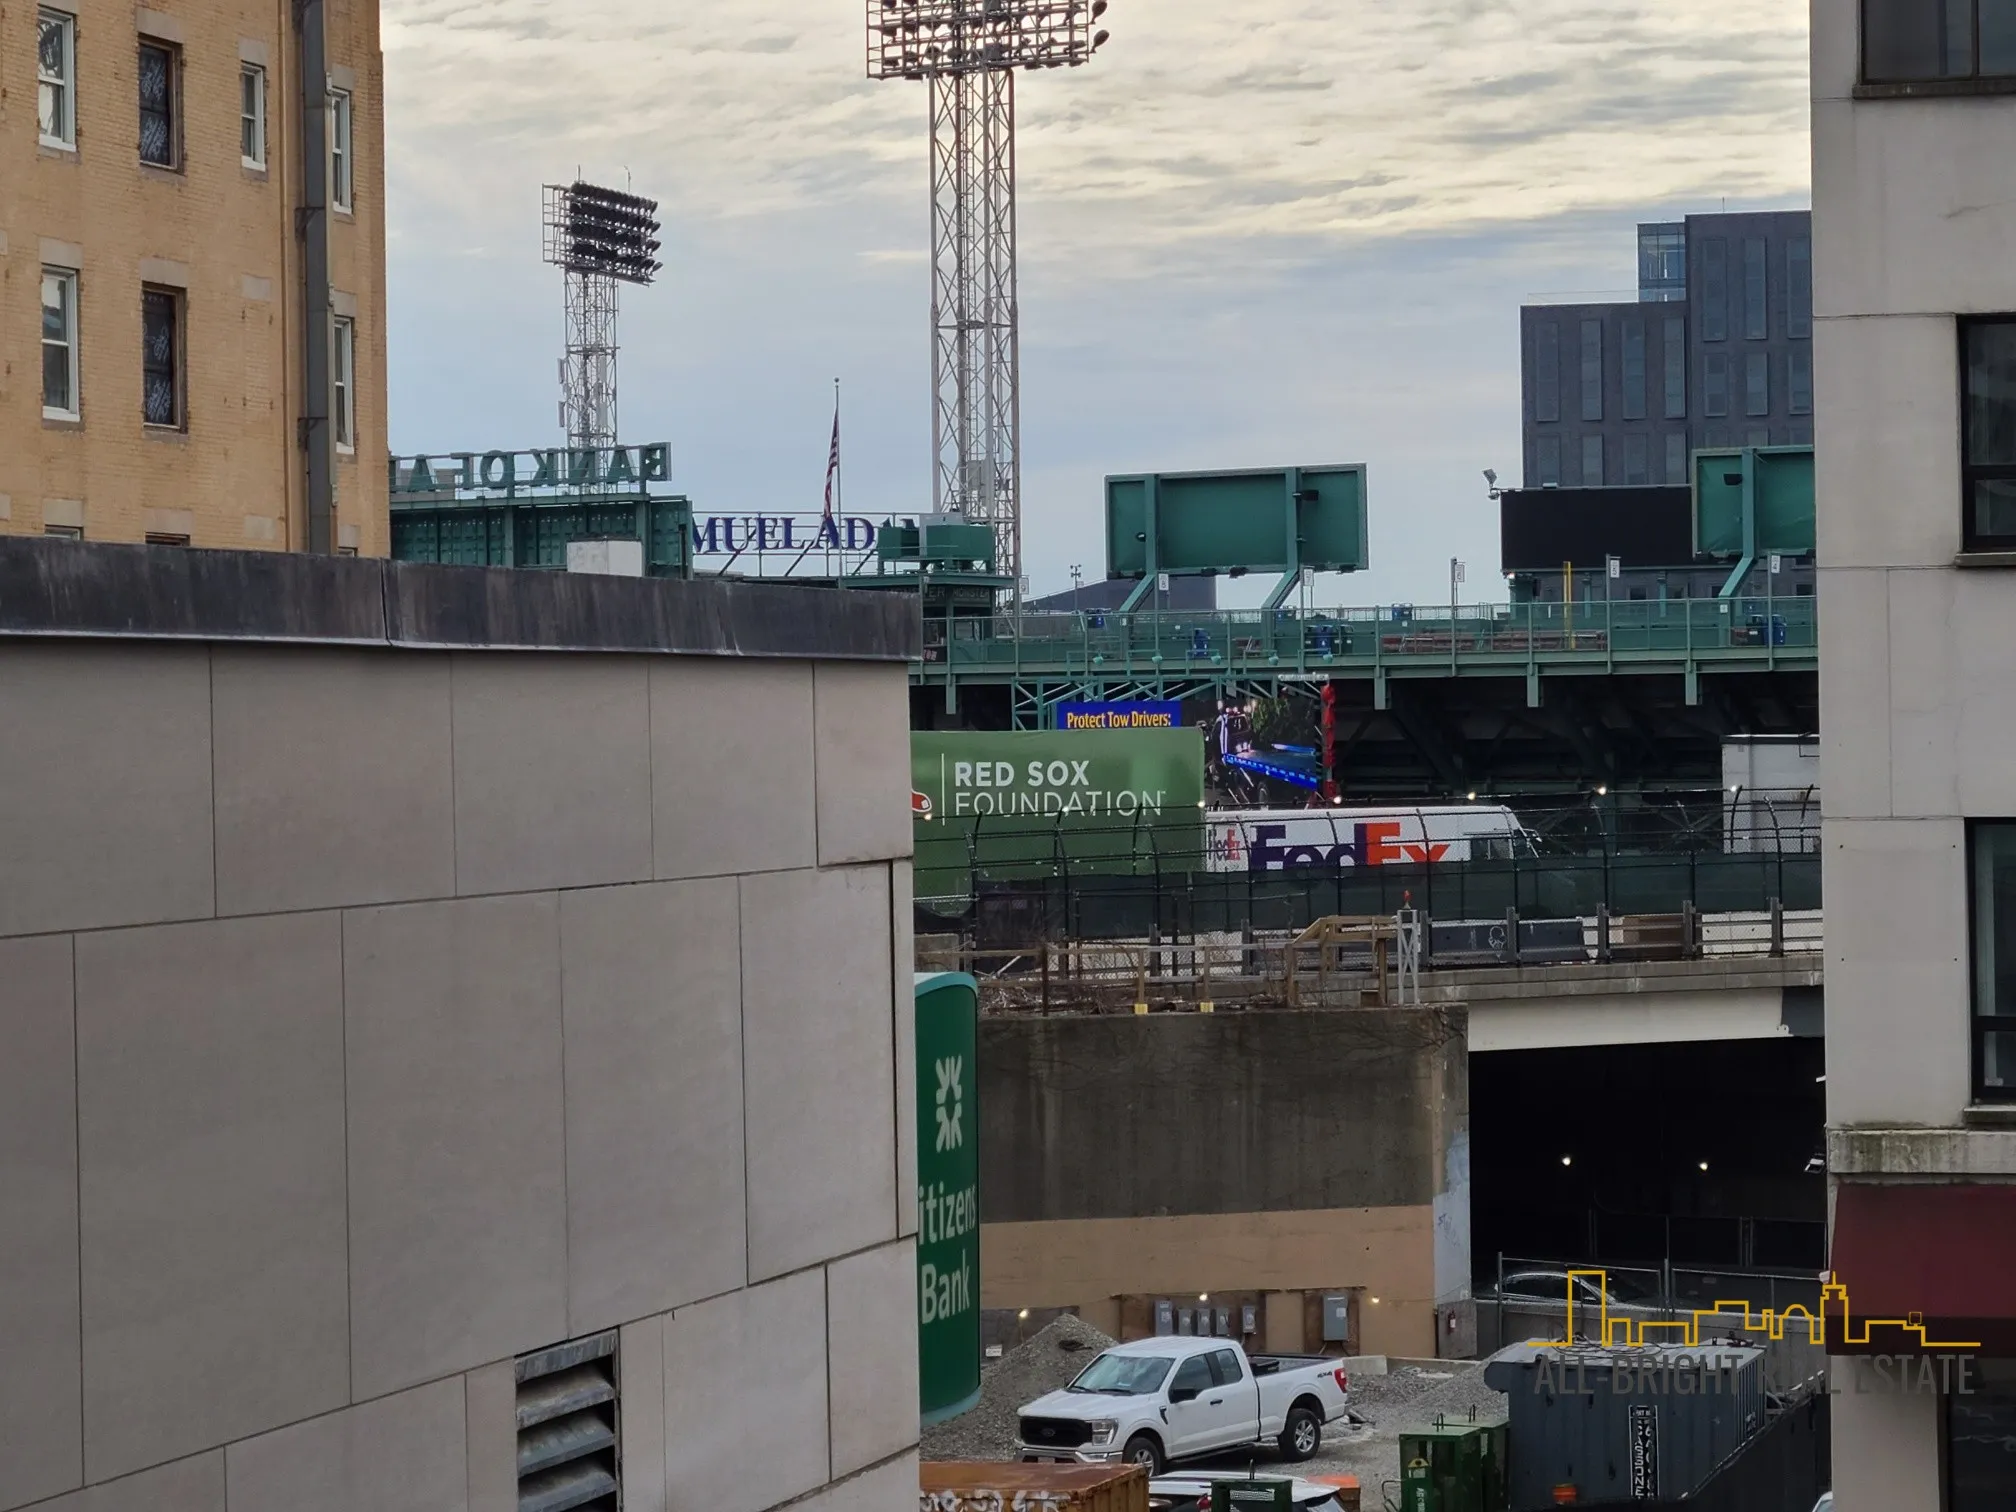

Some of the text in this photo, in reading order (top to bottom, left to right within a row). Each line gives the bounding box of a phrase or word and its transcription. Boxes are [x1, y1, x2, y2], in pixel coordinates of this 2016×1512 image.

[1067, 711, 1171, 728] Protect Tow Drivers:
[955, 760, 1090, 787] RED SOX
[955, 790, 1161, 817] FOUNDATION
[921, 1248, 970, 1325] Bank
